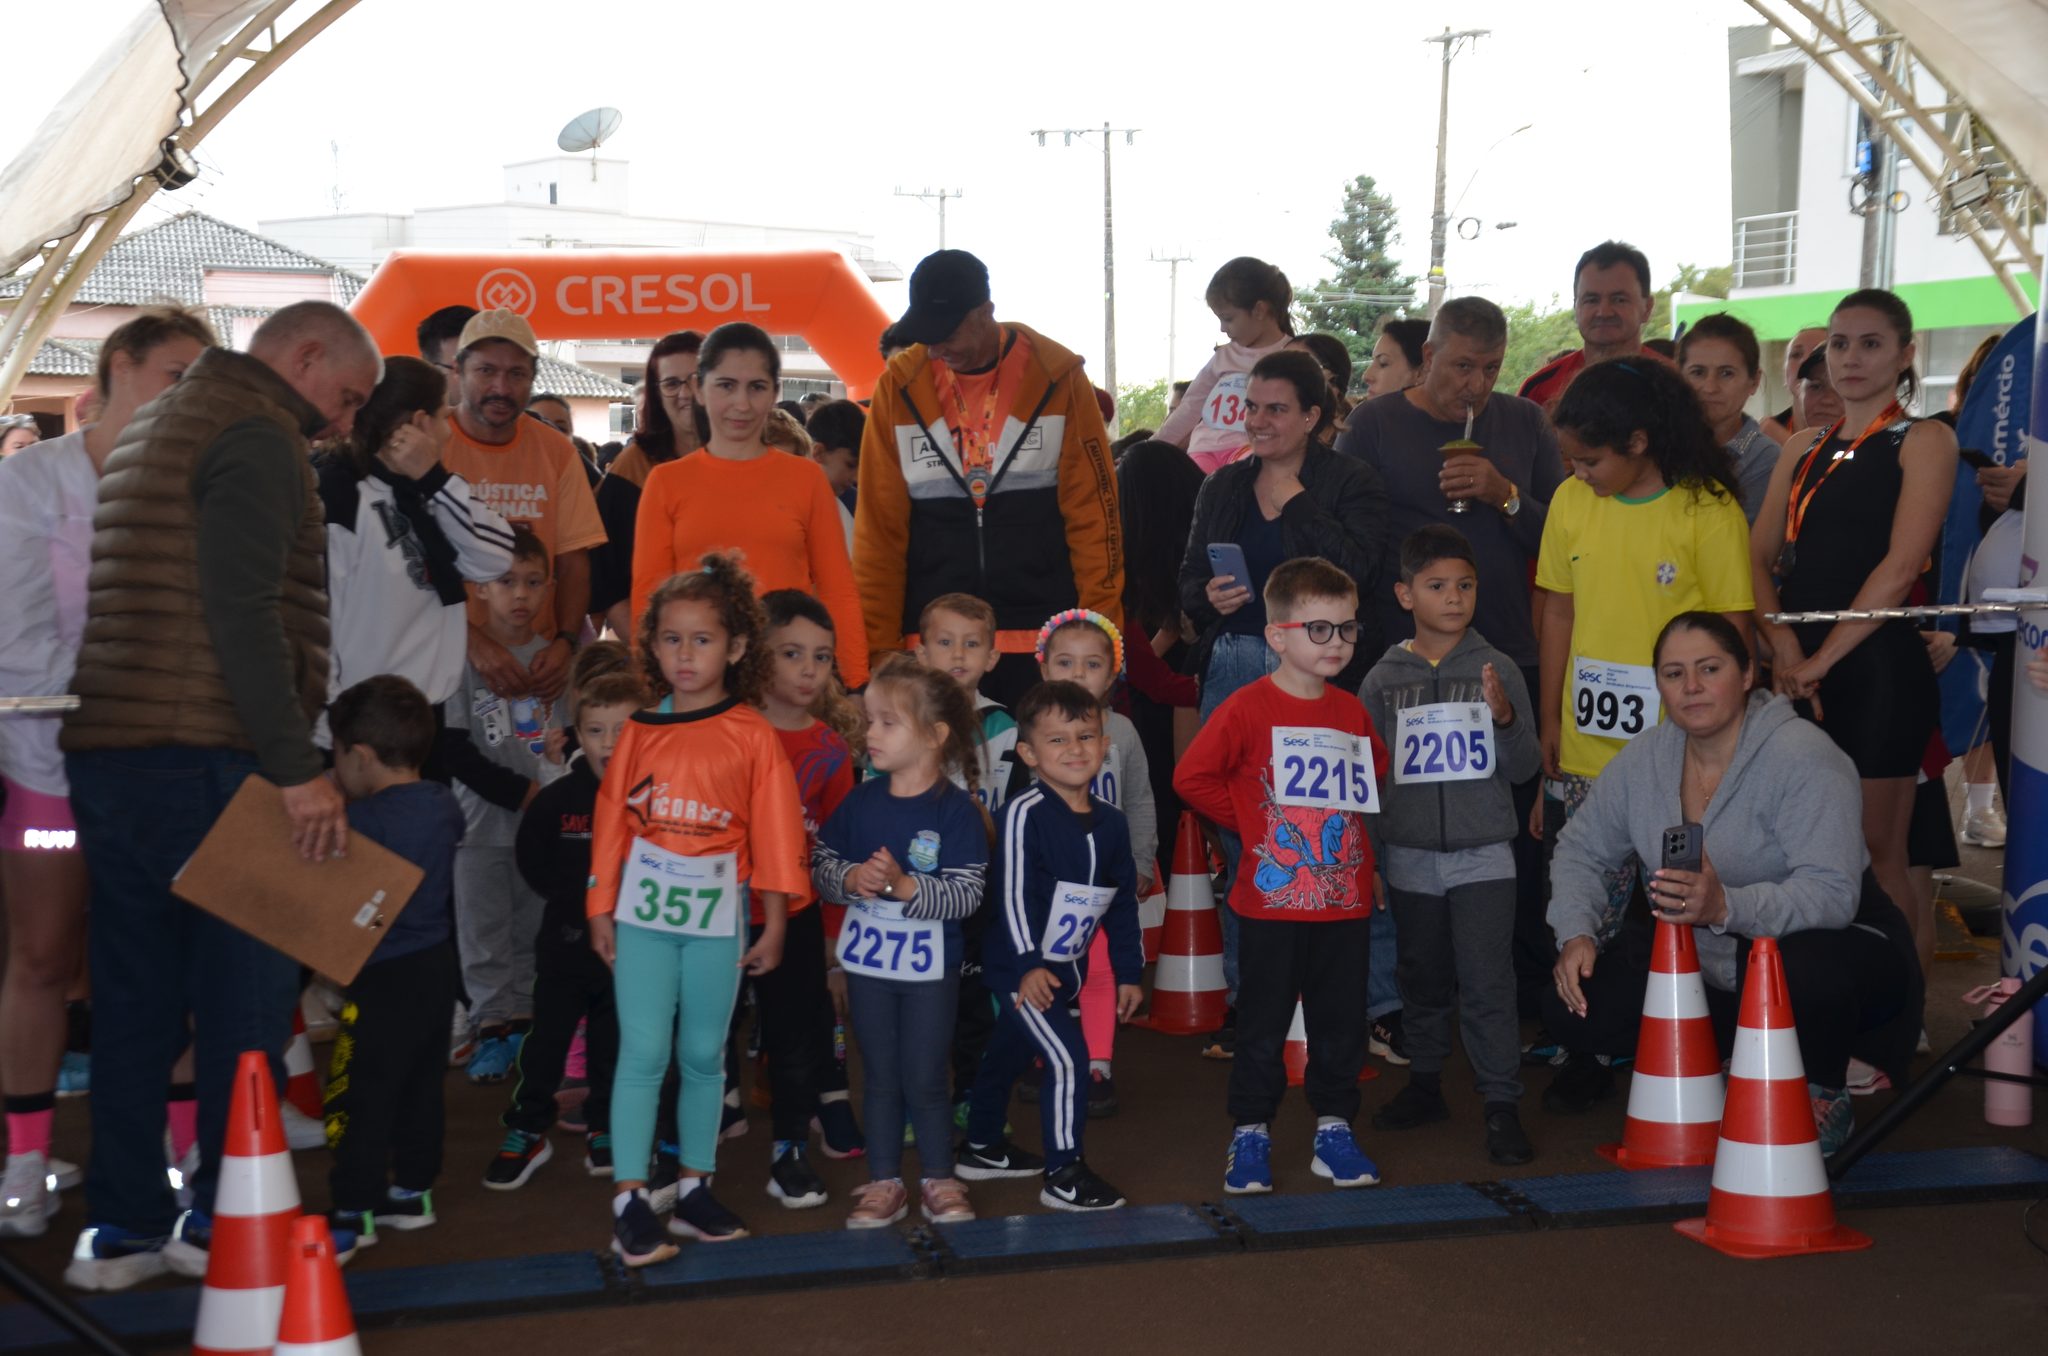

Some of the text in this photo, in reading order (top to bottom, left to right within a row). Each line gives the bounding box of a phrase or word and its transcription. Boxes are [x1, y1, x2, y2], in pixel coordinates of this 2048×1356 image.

[556, 273, 771, 315] CRESOL
[1576, 687, 1644, 734] 993
[1402, 730, 1489, 775] 2205
[1284, 754, 1369, 804] 2215
[24, 829, 76, 849] RUN
[634, 877, 723, 929] 357
[842, 918, 934, 973] 2275
